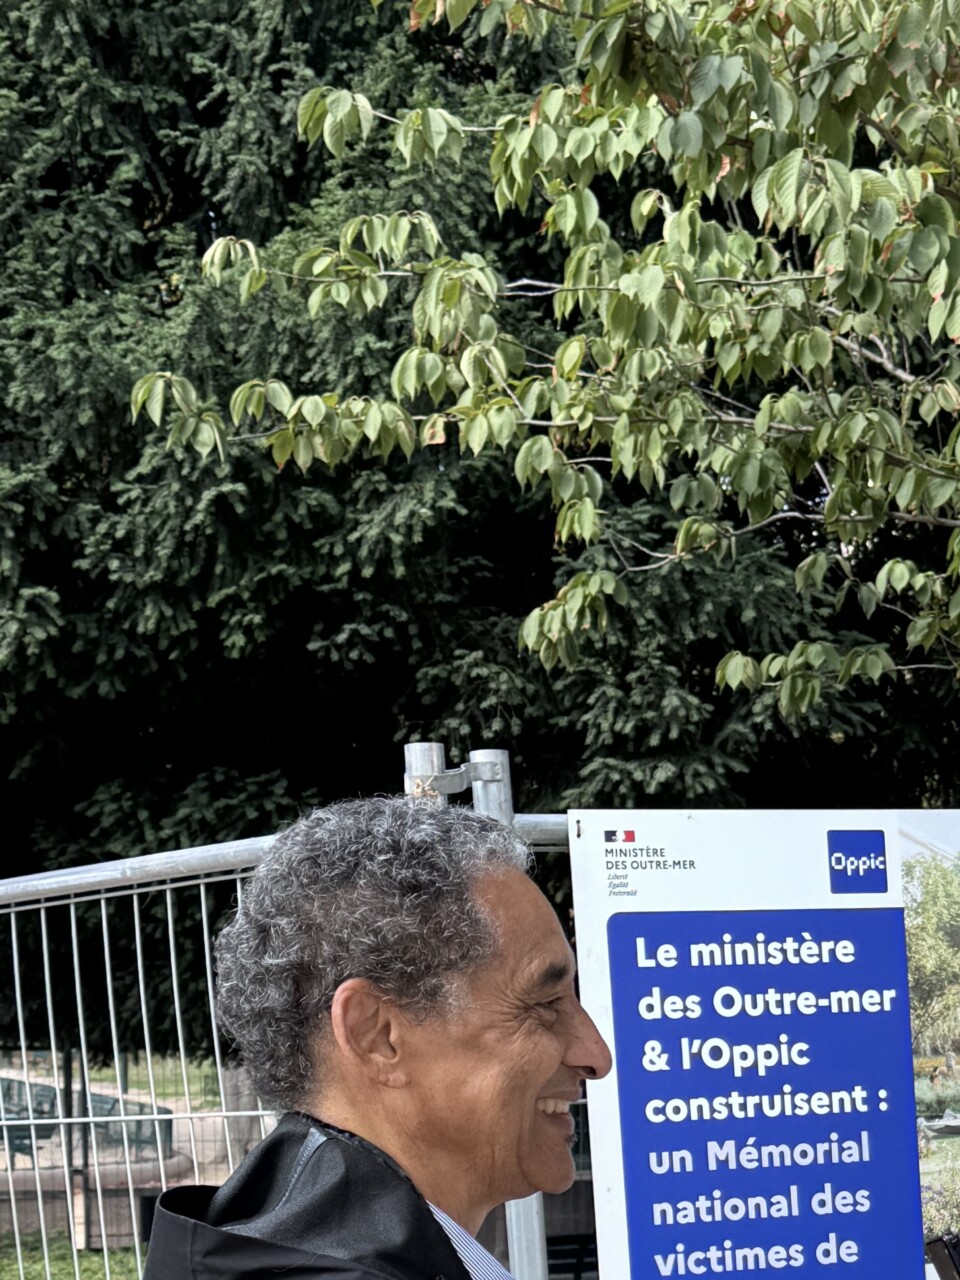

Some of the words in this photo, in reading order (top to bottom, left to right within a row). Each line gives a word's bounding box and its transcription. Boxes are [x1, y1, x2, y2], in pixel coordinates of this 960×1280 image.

[605, 846, 666, 858] MINISTÈRE
[606, 860, 627, 870] DES
[630, 860, 696, 870] OUTRE-MER
[830, 852, 886, 876] Oppic
[636, 937, 677, 968] Le
[690, 932, 855, 967] ministère
[638, 986, 701, 1020] des
[713, 983, 896, 1018] Outre-mer
[642, 1040, 670, 1072] &
[681, 1032, 810, 1077] l'Oppic
[645, 1082, 868, 1124] construisent
[879, 1087, 888, 1112] :
[648, 1143, 692, 1174] un
[707, 1131, 870, 1172] Mémorial
[652, 1185, 800, 1226] national
[810, 1182, 870, 1215] des
[654, 1239, 804, 1278] victimes
[815, 1232, 859, 1265] de
